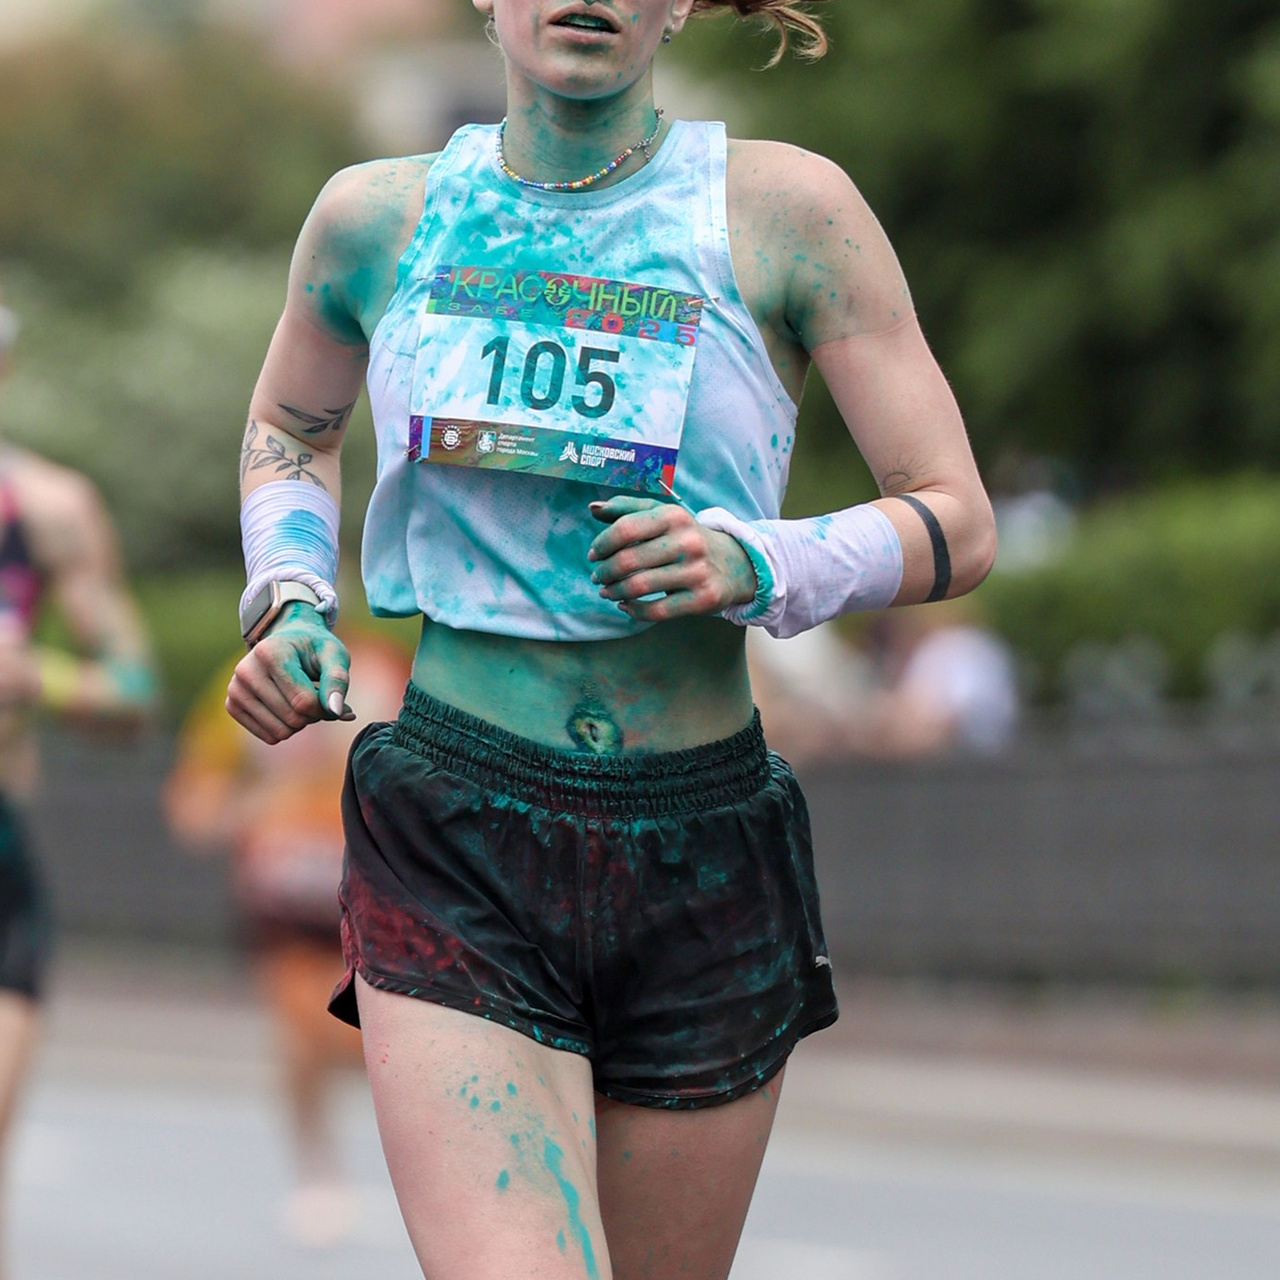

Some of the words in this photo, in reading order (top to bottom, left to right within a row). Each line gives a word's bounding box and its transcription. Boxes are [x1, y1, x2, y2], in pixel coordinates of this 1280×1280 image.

[451, 269, 677, 322] КРАСОЧНЫЙ
[447, 302, 536, 318] ЗАБЕ
[565, 310, 696, 346] 2025
[480, 336, 621, 418] 105
[580, 454, 607, 468] СПОРТ
[581, 443, 636, 463] МОСКОВСКИЙ
